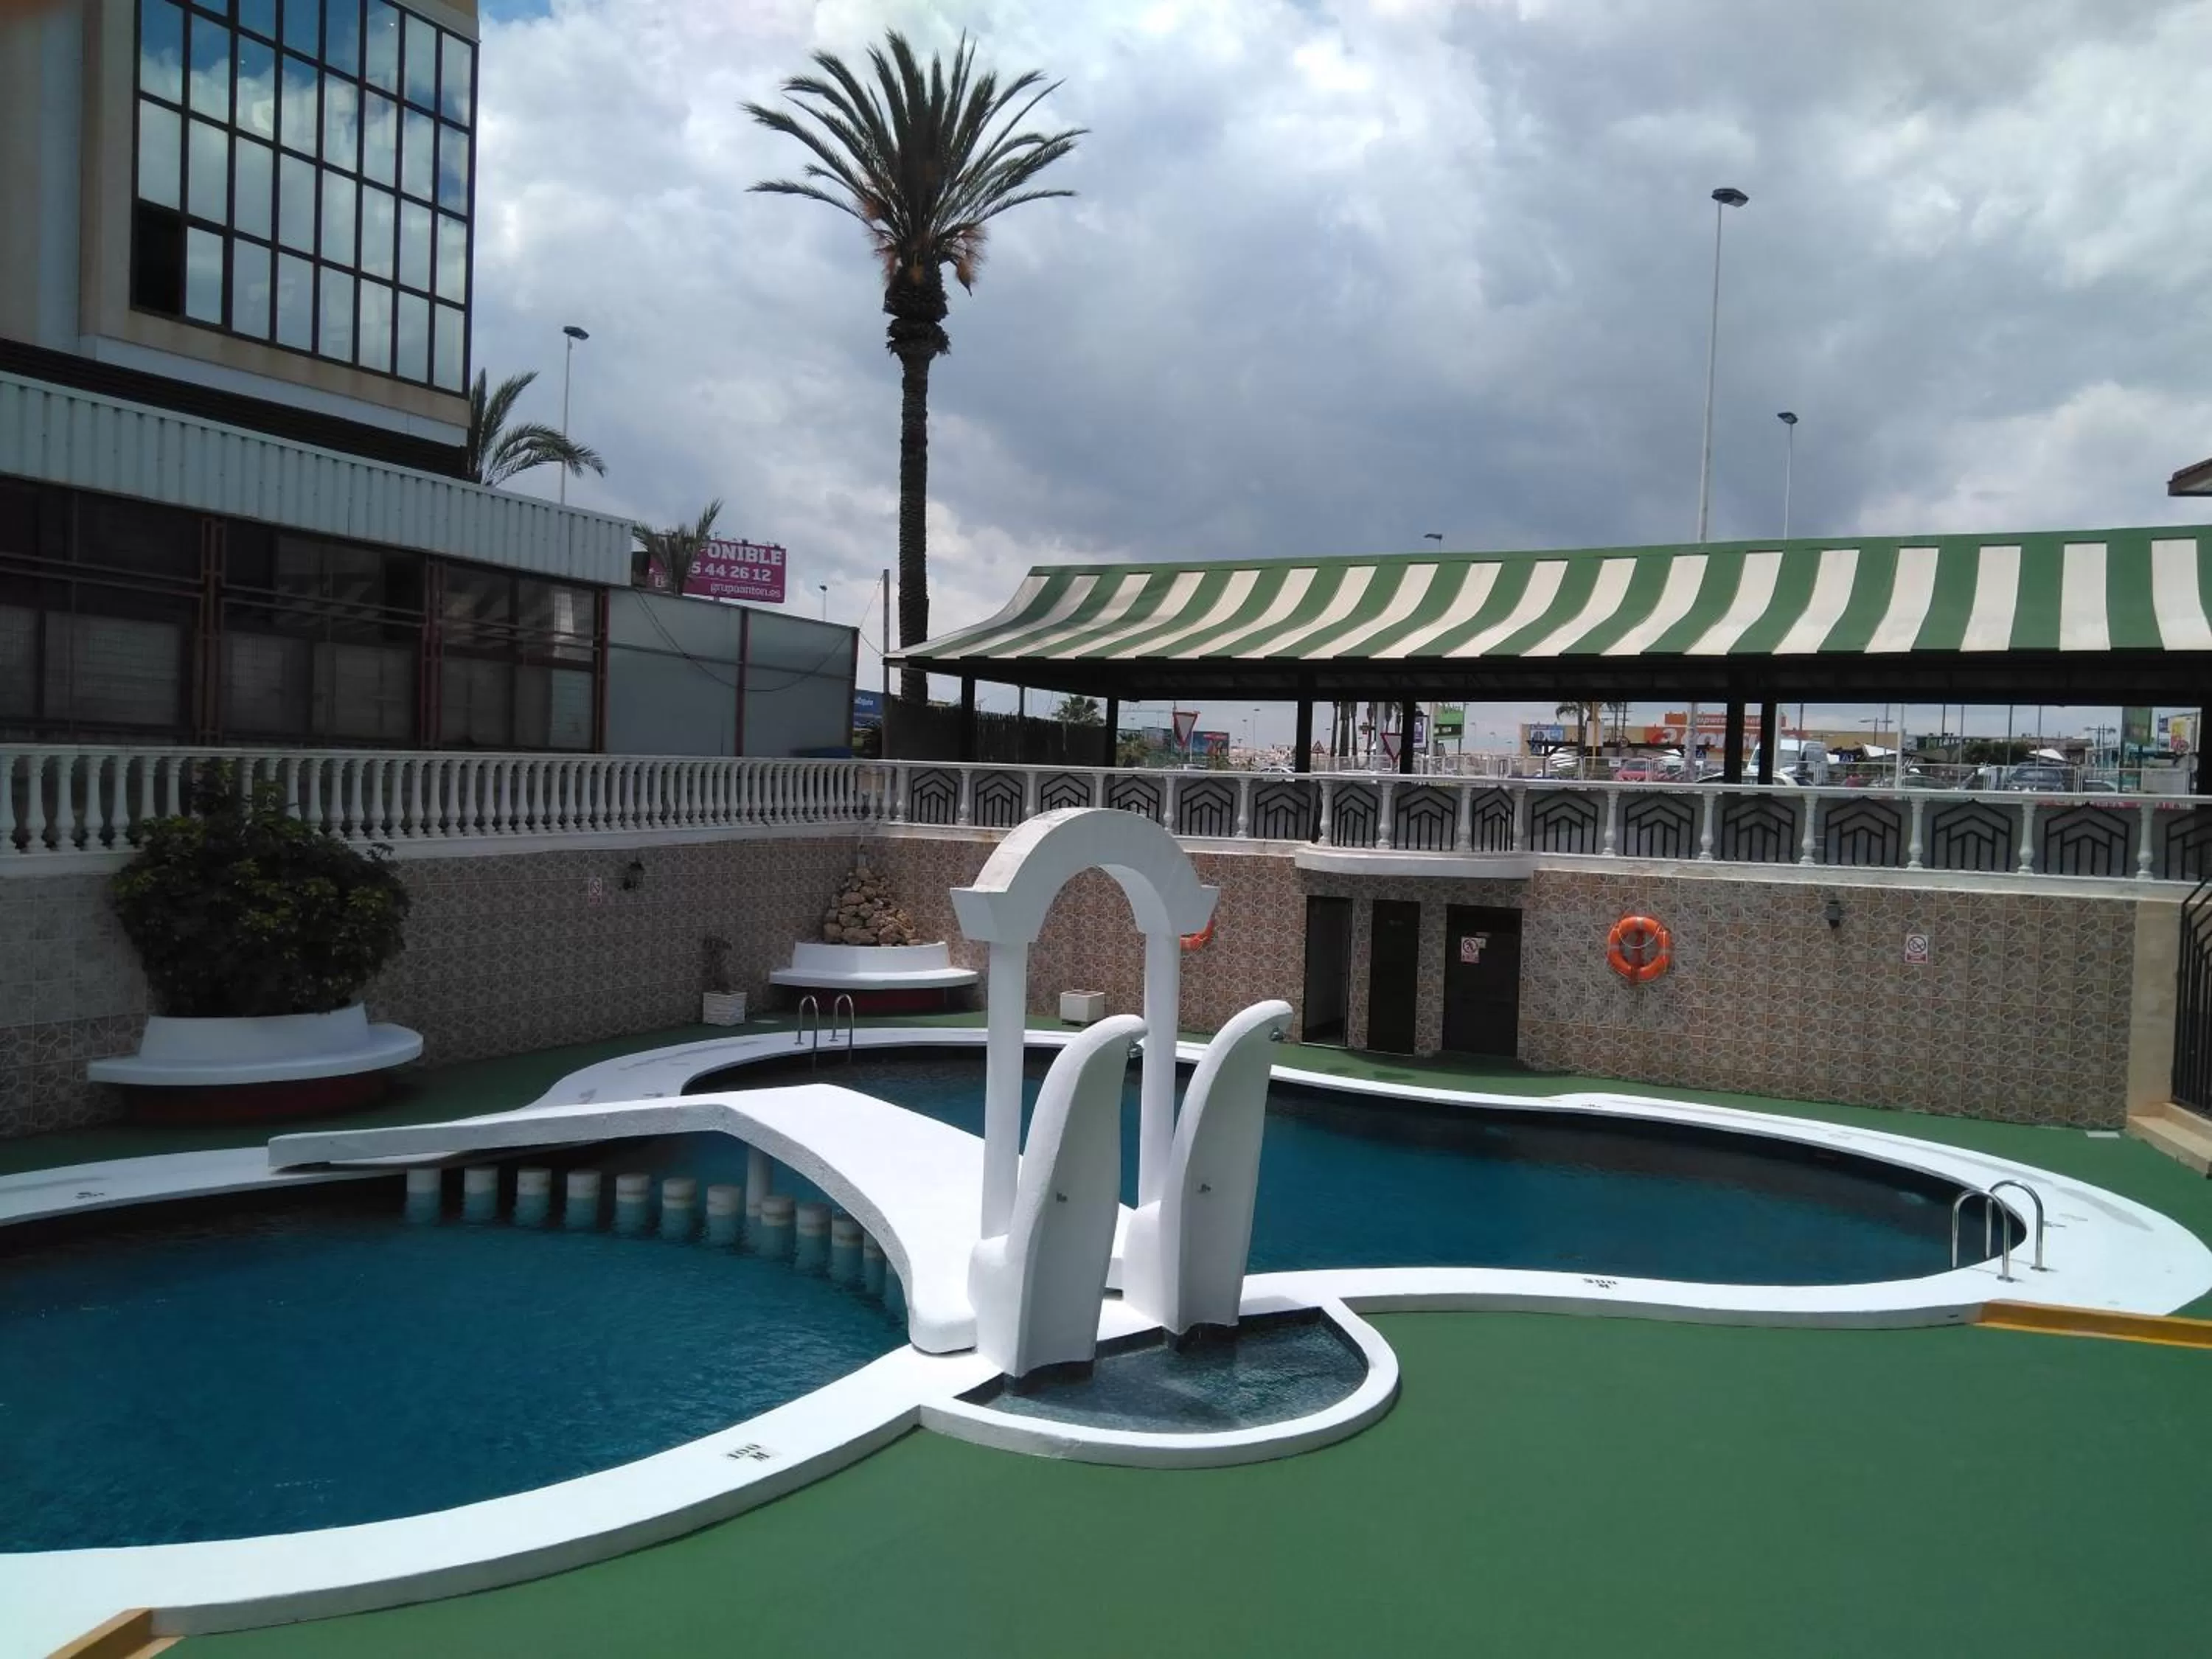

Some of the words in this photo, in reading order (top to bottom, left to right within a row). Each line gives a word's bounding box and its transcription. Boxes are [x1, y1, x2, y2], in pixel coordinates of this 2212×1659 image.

[706, 542, 782, 566] ONIBLE
[704, 563, 726, 577] 44
[729, 566, 750, 579] 26
[752, 568, 772, 582] 12
